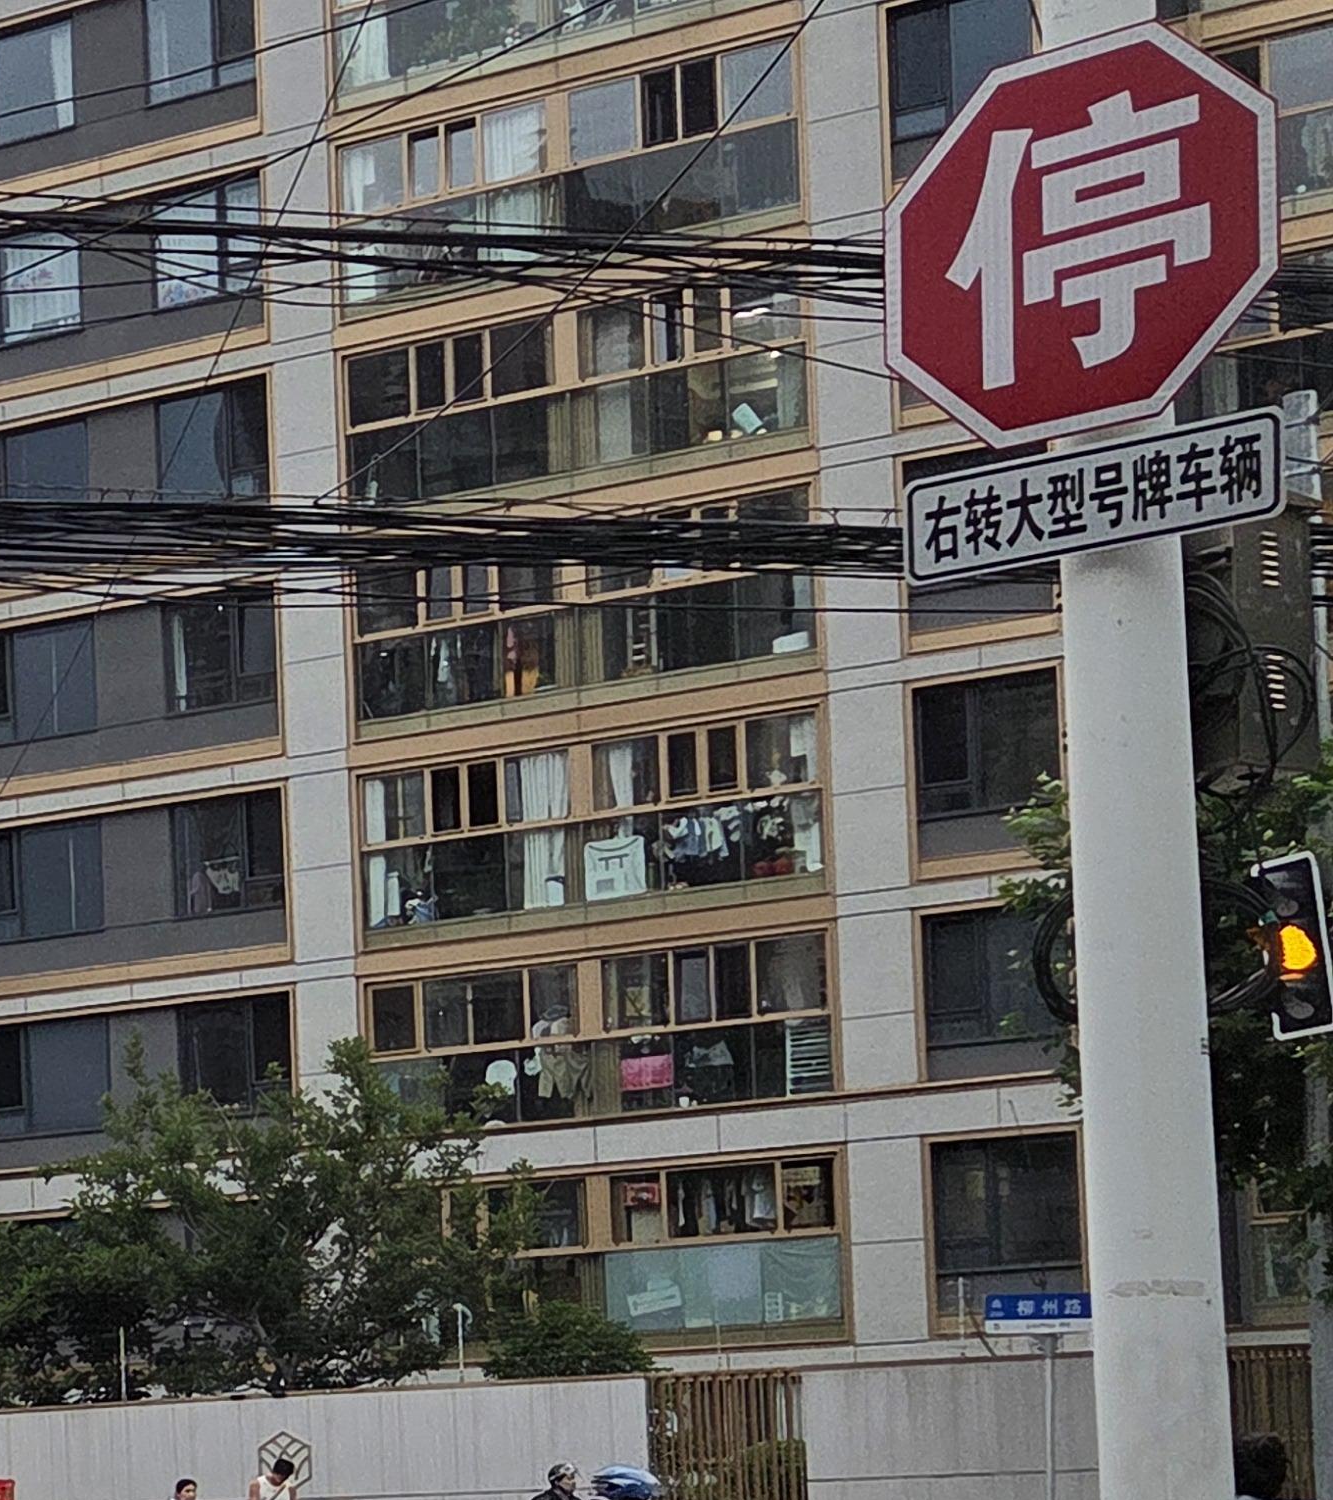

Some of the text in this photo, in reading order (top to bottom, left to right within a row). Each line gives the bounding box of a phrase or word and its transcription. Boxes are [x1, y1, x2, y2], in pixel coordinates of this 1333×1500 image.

[944, 90, 1211, 390] 停
[925, 432, 1263, 563] 右转大型号牌车辆
